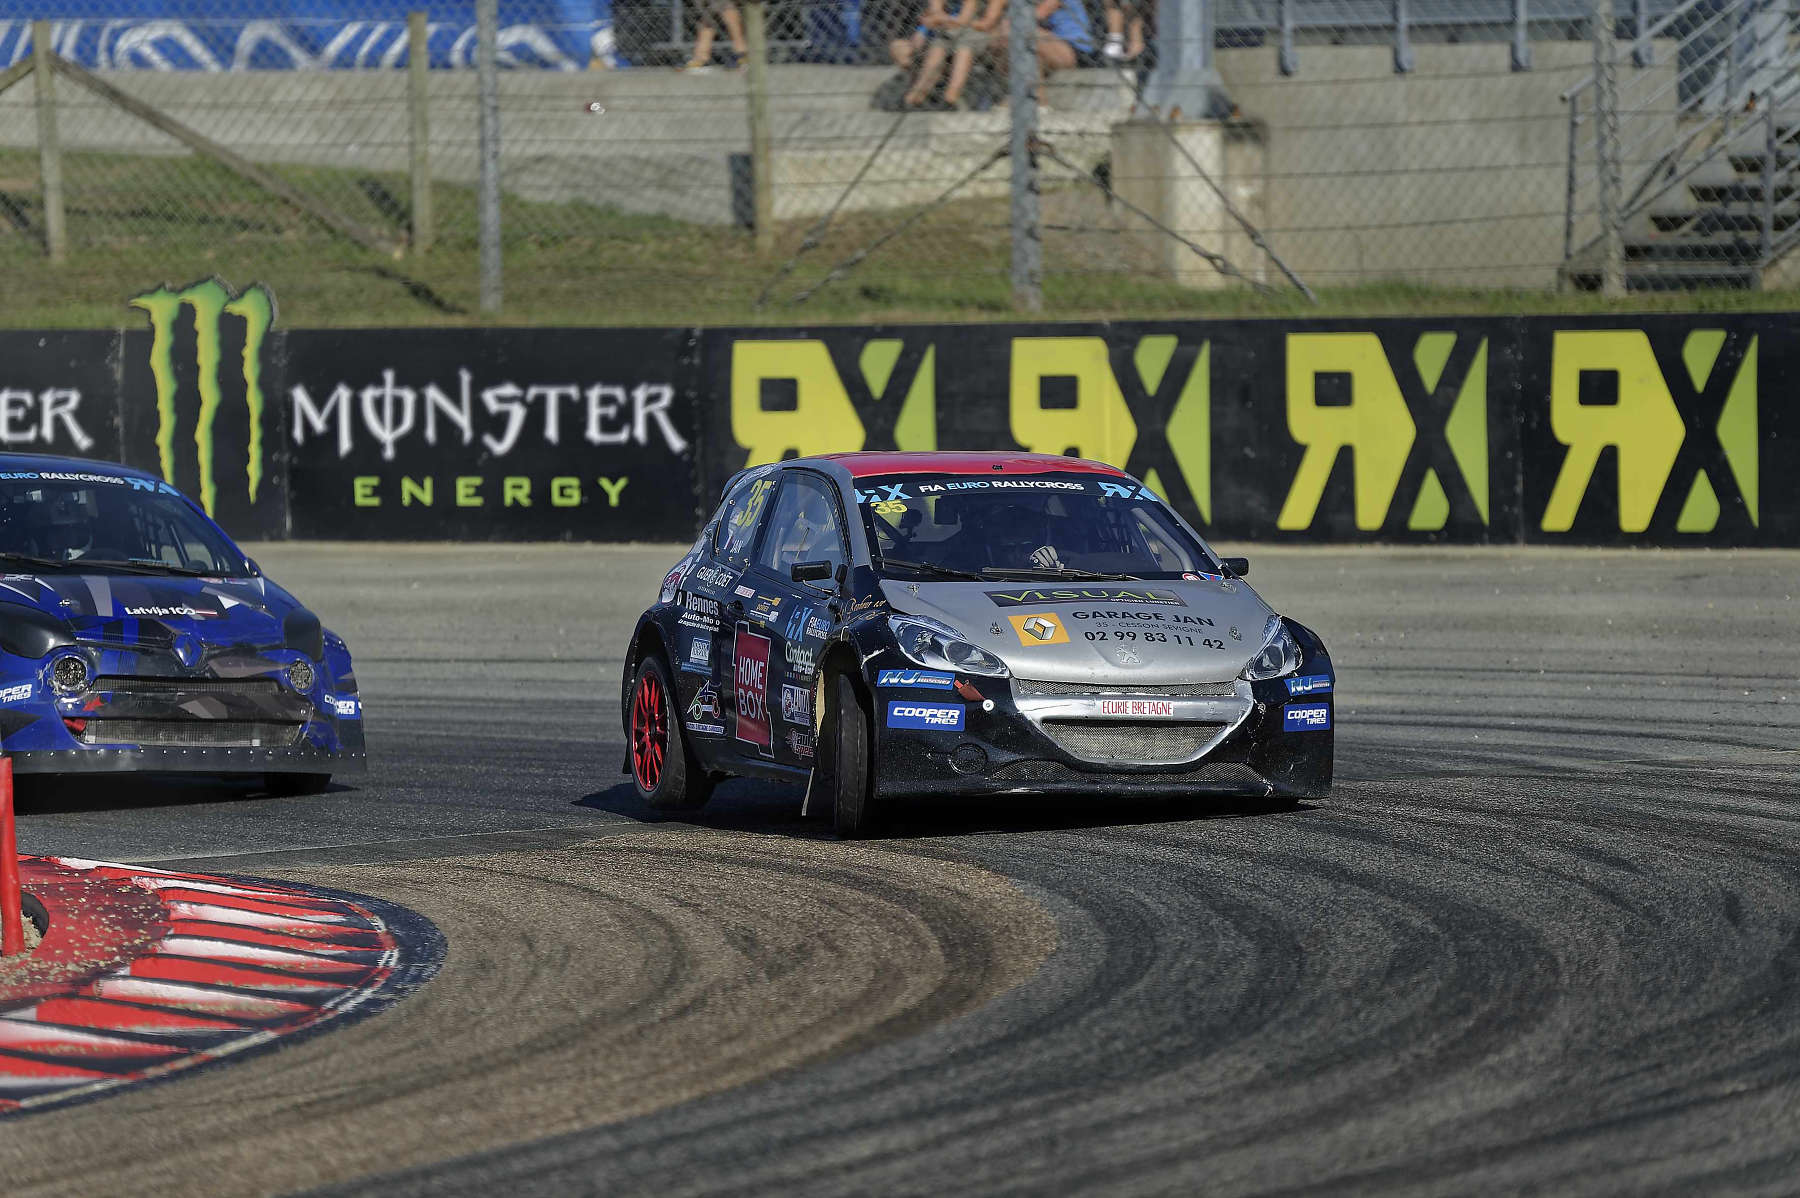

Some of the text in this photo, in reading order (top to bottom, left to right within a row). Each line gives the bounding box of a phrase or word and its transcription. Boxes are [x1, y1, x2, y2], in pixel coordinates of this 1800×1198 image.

[290, 368, 688, 461] MONSTER
[1276, 331, 1490, 531] RX
[1541, 329, 1760, 533] RX
[0, 471, 125, 485] EURO RALLYCROSS
[353, 475, 629, 508] ENERGY
[919, 480, 1085, 494] FIA EURO RALLYCROSS
[735, 479, 773, 527] 35
[870, 500, 908, 514] 35
[685, 591, 720, 616] Rennes
[1072, 611, 1215, 627] GARAGE JAN
[1084, 631, 1226, 650] 02 99 83 11 42
[738, 655, 765, 690] HOME
[738, 687, 766, 721] BOX
[893, 706, 961, 719] COOPER
[1102, 700, 1173, 716] ECURIE BRETAGNE
[924, 716, 958, 726] TIRES
[1287, 708, 1327, 720] COOPER
[1305, 717, 1327, 725] TIRES
